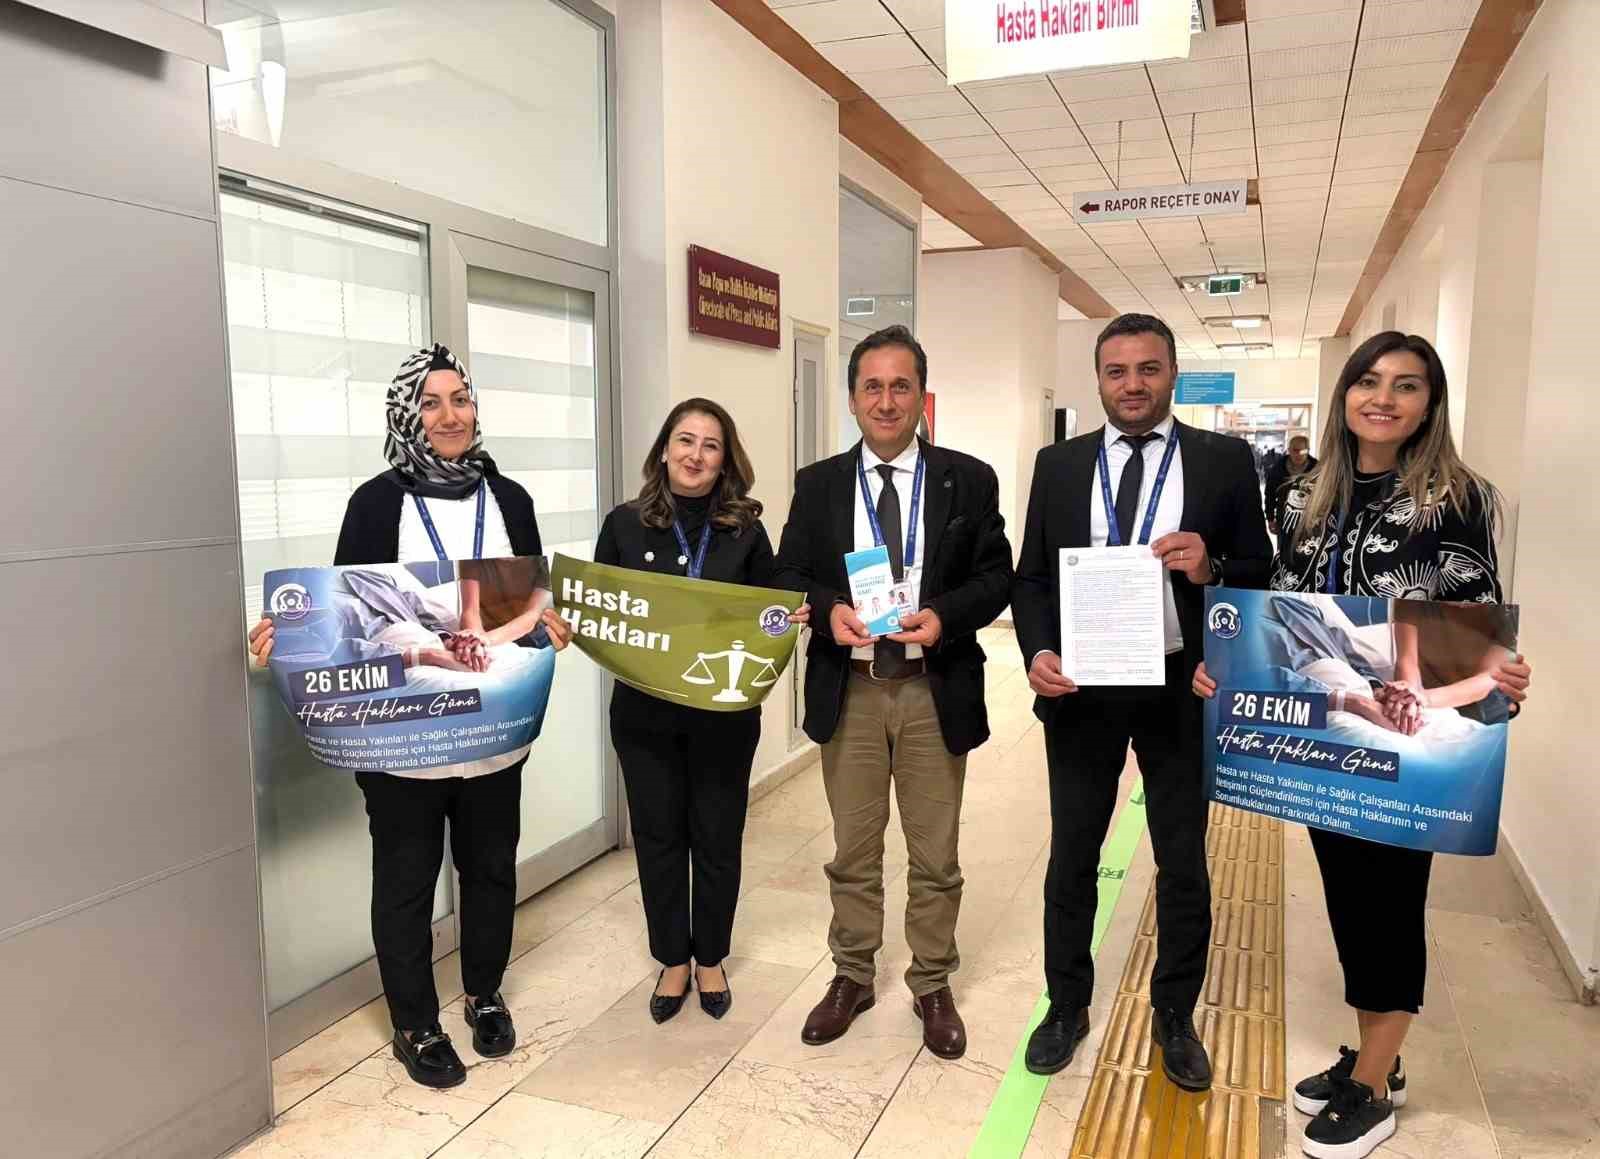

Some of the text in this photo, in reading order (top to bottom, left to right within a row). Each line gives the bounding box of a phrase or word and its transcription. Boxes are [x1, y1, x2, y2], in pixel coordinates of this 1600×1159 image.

[997, 3, 1036, 43] Hasta
[1040, 0, 1092, 38] Hakları
[1105, 190, 1240, 212] RAPOR REÇETE ONAY
[560, 577, 671, 653] Hasta Hakları
[305, 663, 389, 693] 26 EKİM
[297, 693, 479, 728] Hasta Hakları Günü
[1231, 692, 1311, 726] 26 EKİM
[341, 736, 367, 747] Hasta
[422, 729, 449, 742] Sağlık
[1216, 724, 1396, 774] Hasta Hakları Günü
[1215, 790, 1280, 814] Sorumluluklarının
[1282, 805, 1320, 823] Farkında
[1216, 764, 1473, 823] Hasta ve Hasta Yakınları ile Sağlık Çalışanları Arasındaki
[1248, 785, 1313, 808] Güçlendirilmesi
[1332, 802, 1358, 817] Hasta
[1360, 808, 1412, 828] Haklarının
[1414, 819, 1428, 831] ve
